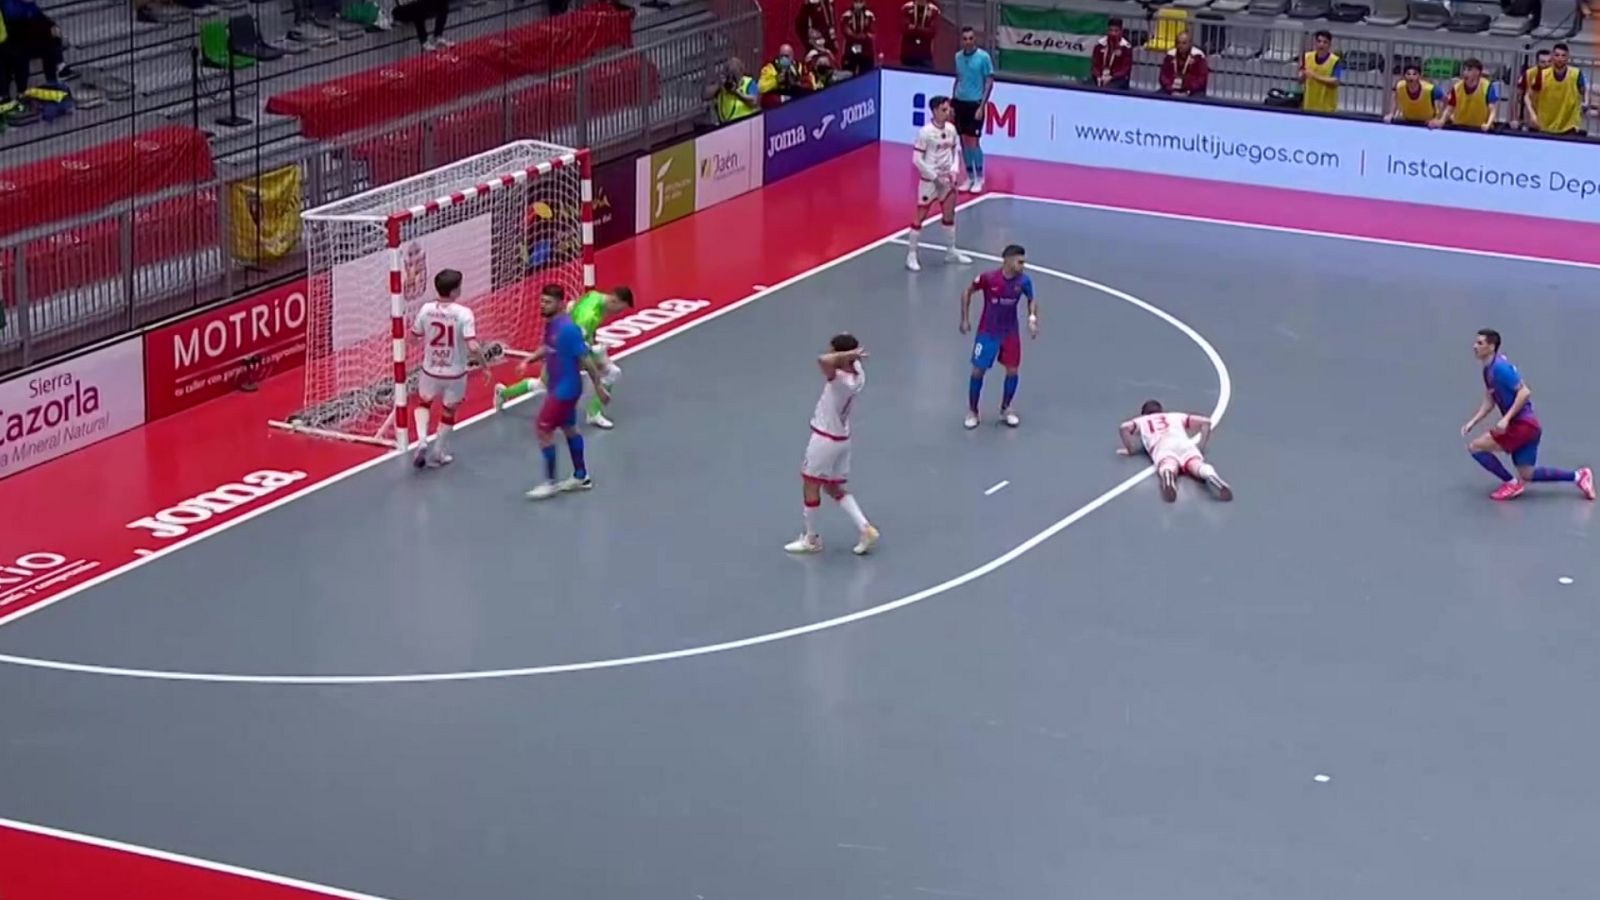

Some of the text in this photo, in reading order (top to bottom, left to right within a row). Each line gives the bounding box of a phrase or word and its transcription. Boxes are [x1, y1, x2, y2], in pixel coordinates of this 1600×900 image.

[1016, 32, 1086, 52] Lopera
[1075, 124, 1340, 168] www.stmmultijuegos.com
[1387, 154, 1600, 199] Instalaciones Dep
[429, 321, 455, 348] 21
[29, 372, 73, 399] Sierra
[0, 380, 100, 446] azorla
[1147, 416, 1169, 434] 13
[12, 432, 61, 464] Mineral
[60, 411, 110, 443] Natural
[125, 469, 307, 538] Joma
